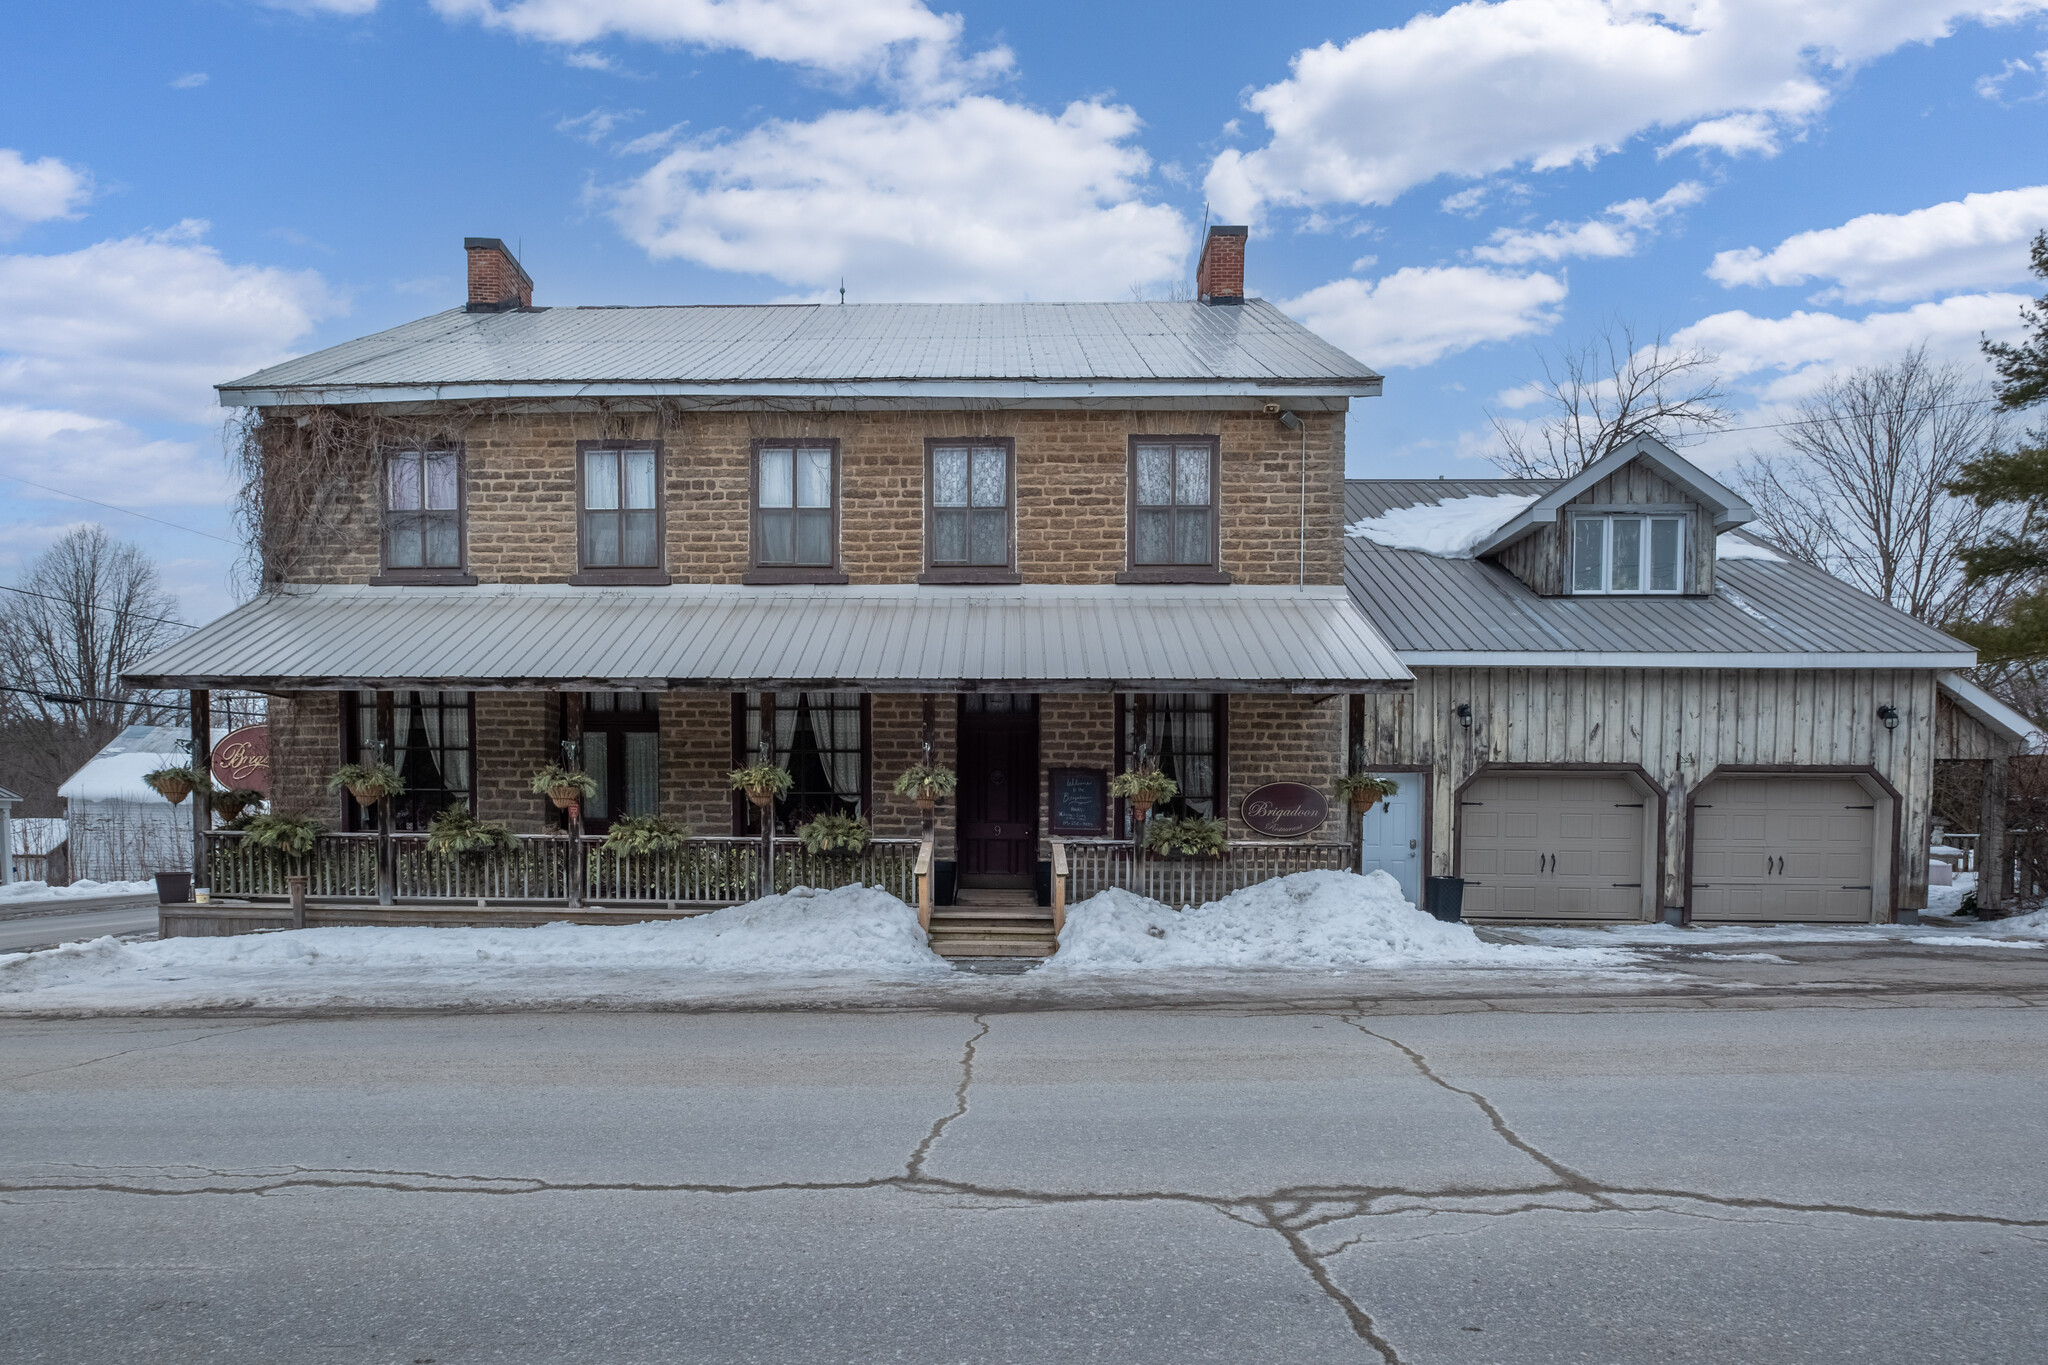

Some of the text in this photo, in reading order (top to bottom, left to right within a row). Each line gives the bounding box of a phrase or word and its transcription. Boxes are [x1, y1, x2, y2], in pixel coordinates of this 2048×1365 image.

[1248, 801, 1319, 823] Brigadoon
[994, 825, 1001, 836] 9
[1265, 823, 1303, 832] Restaurant
